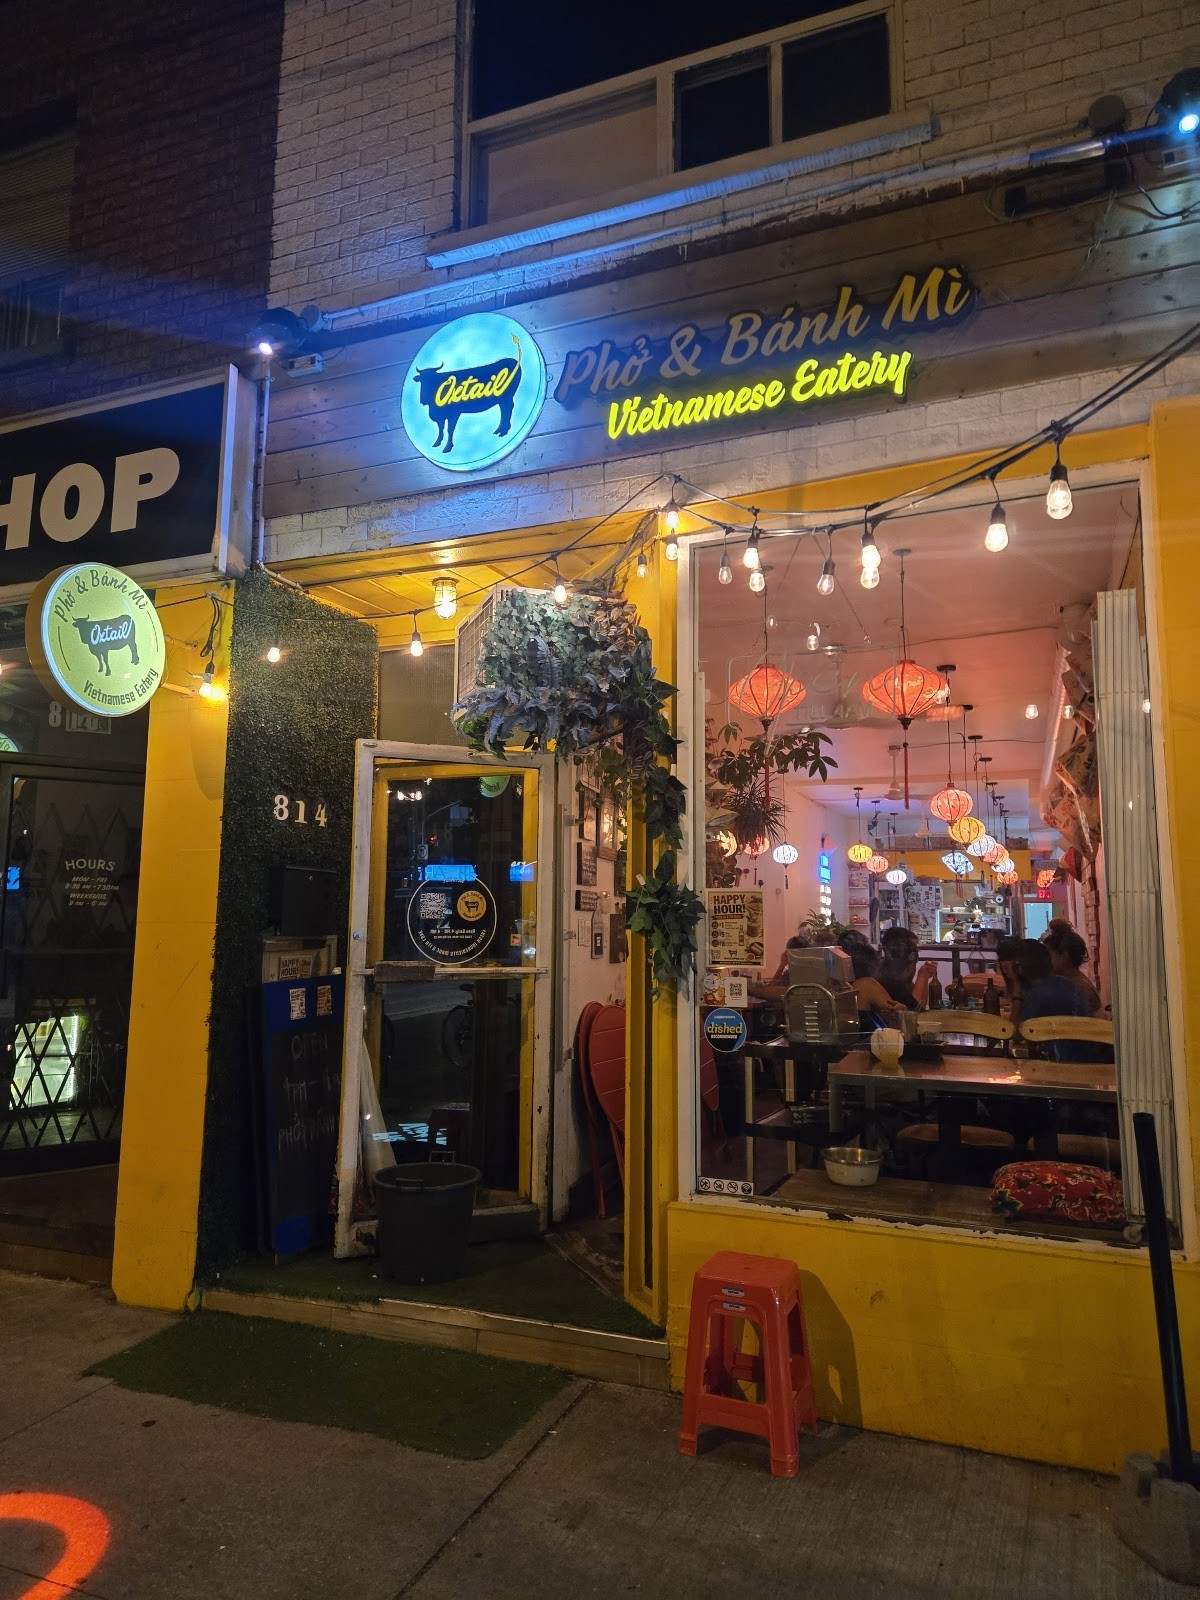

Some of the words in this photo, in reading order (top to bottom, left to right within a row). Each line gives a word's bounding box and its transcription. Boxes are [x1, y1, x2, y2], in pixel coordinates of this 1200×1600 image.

[659, 325, 702, 379] &
[720, 286, 871, 366] Bánh
[881, 266, 972, 331] Mì
[435, 367, 511, 407] Oxtail
[607, 375, 786, 441] Vietnamese
[791, 350, 913, 402] Eatery
[74, 575, 89, 595] &
[89, 569, 128, 593] Bánh
[90, 620, 131, 645] Oxtail
[83, 679, 136, 706] Vietnamese
[135, 667, 159, 697] Eatery
[273, 794, 328, 828] 814
[65, 858, 116, 872] HOURS
[713, 894, 746, 905] HAPPY
[713, 904, 746, 914] HOUR!
[281, 959, 300, 968] HAPPY
[707, 1021, 743, 1034] dished
